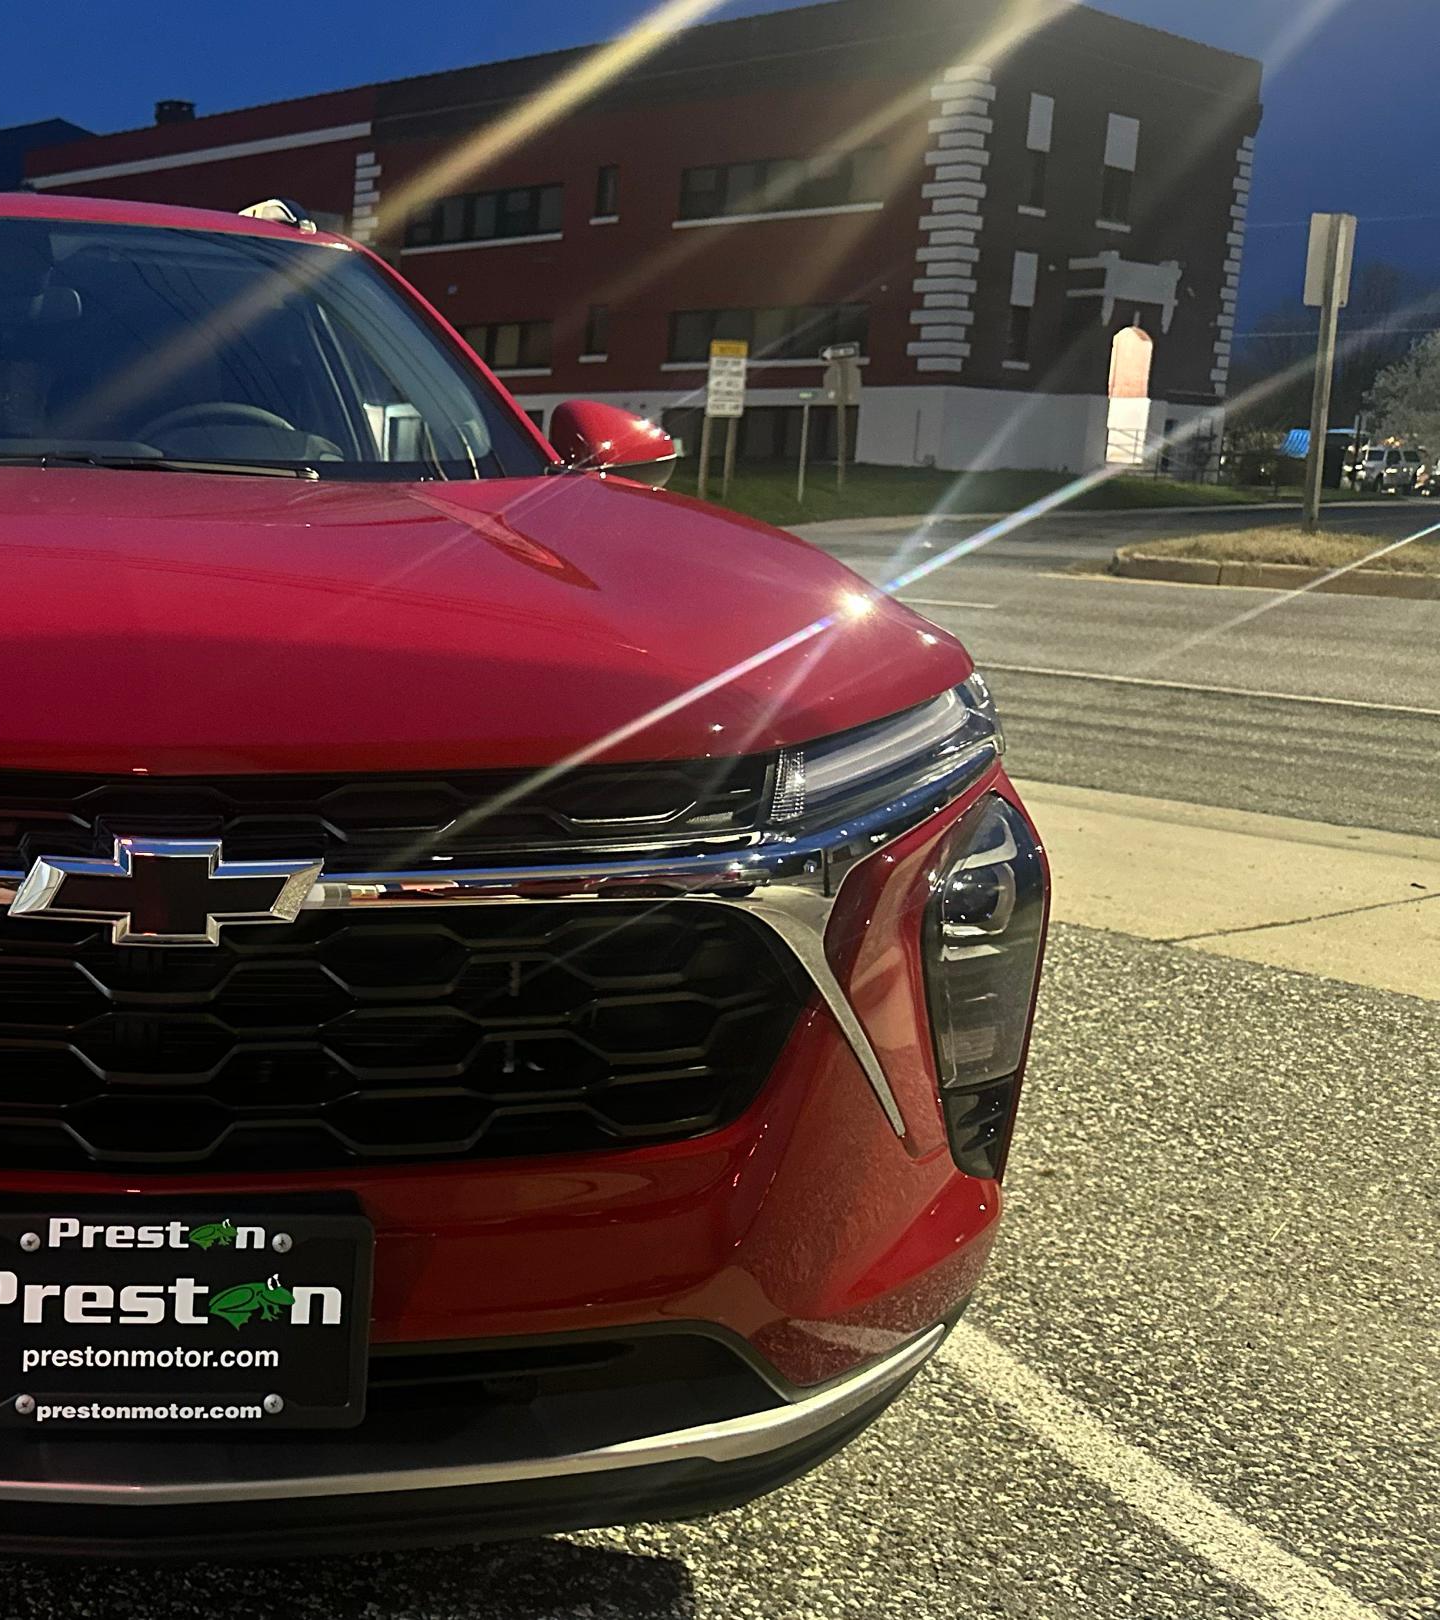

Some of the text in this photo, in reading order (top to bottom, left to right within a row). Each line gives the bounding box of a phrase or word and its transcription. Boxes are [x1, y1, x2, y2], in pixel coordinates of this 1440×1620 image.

[48, 1217, 265, 1250] Prestn
[22, 1345, 279, 1372] prestonmotor.com
[36, 1402, 262, 1421] prestonmotor.com
